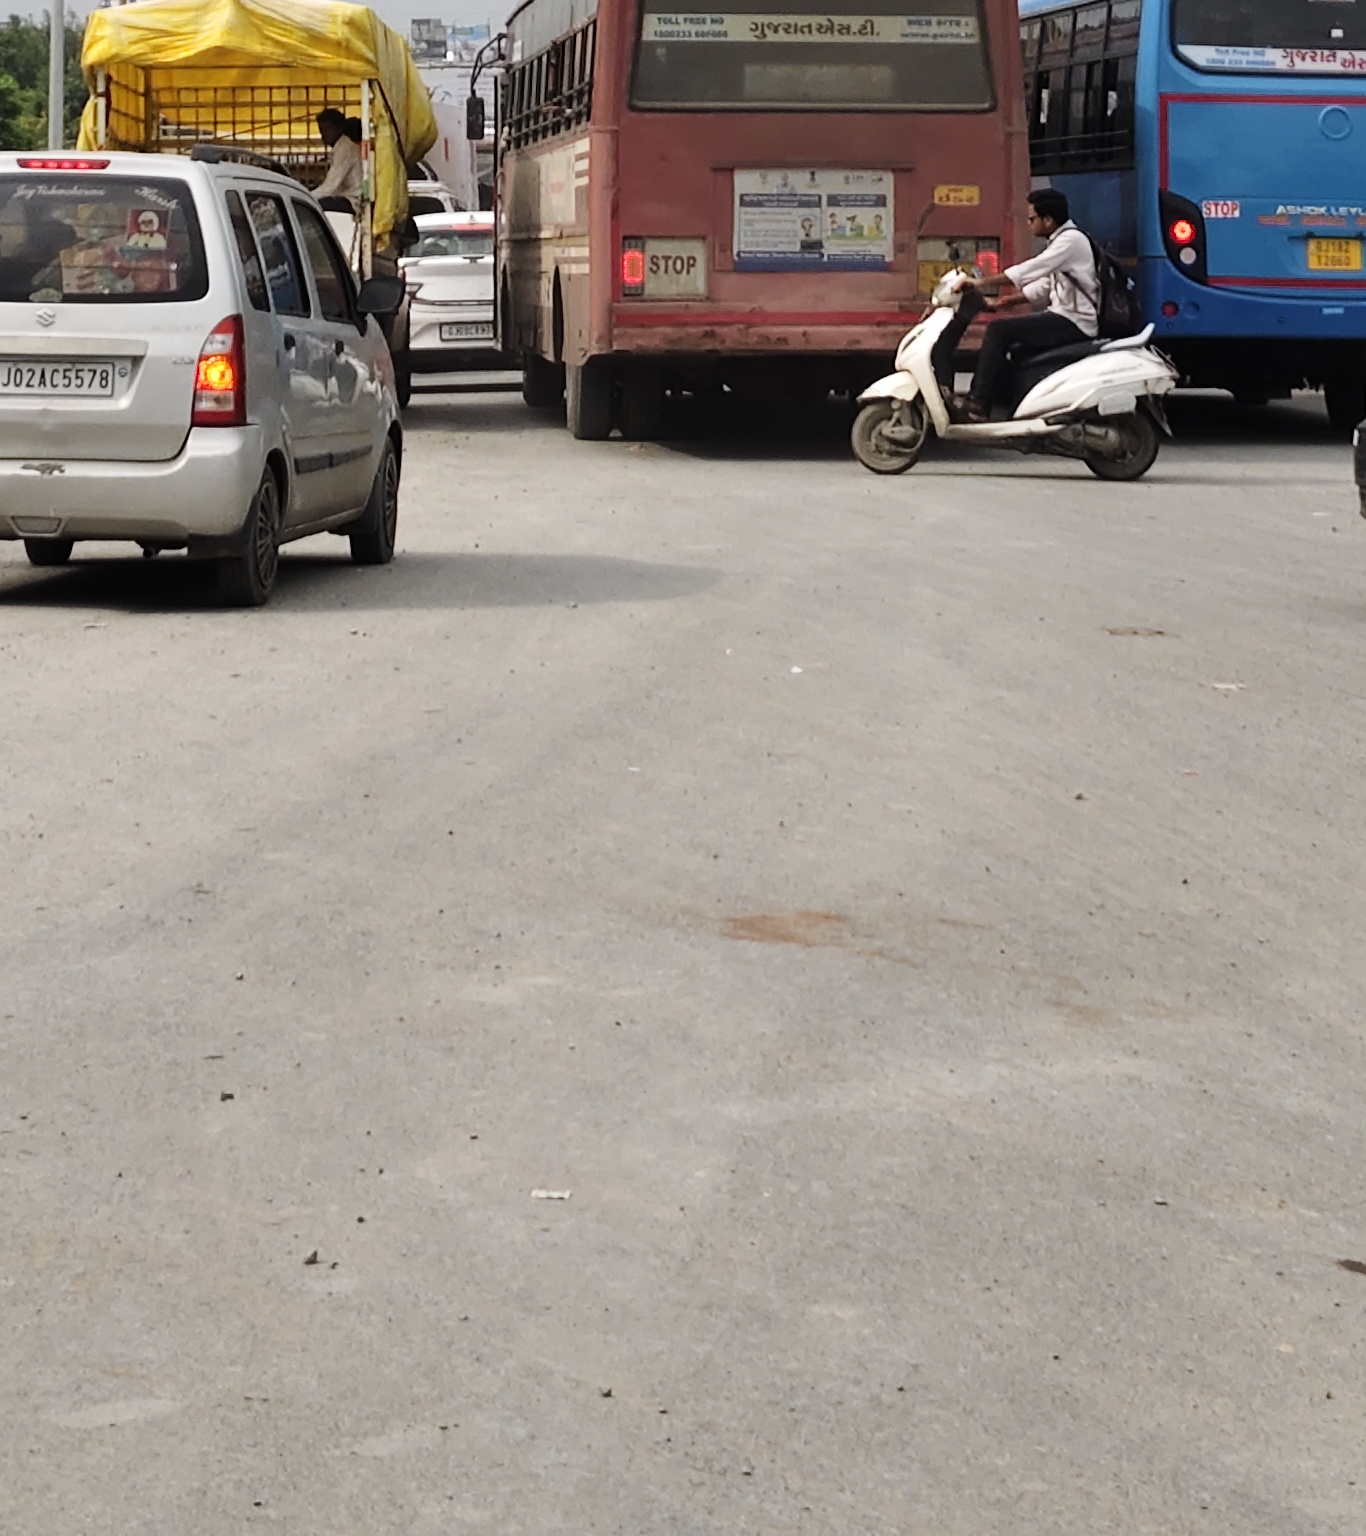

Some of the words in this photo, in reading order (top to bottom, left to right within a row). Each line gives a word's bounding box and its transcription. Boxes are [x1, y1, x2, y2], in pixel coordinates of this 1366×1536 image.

[749, 21, 813, 40] ગુજરાત
[1203, 201, 1240, 218] STOP
[1275, 205, 1329, 216] ASHOK
[648, 255, 698, 276] STOP
